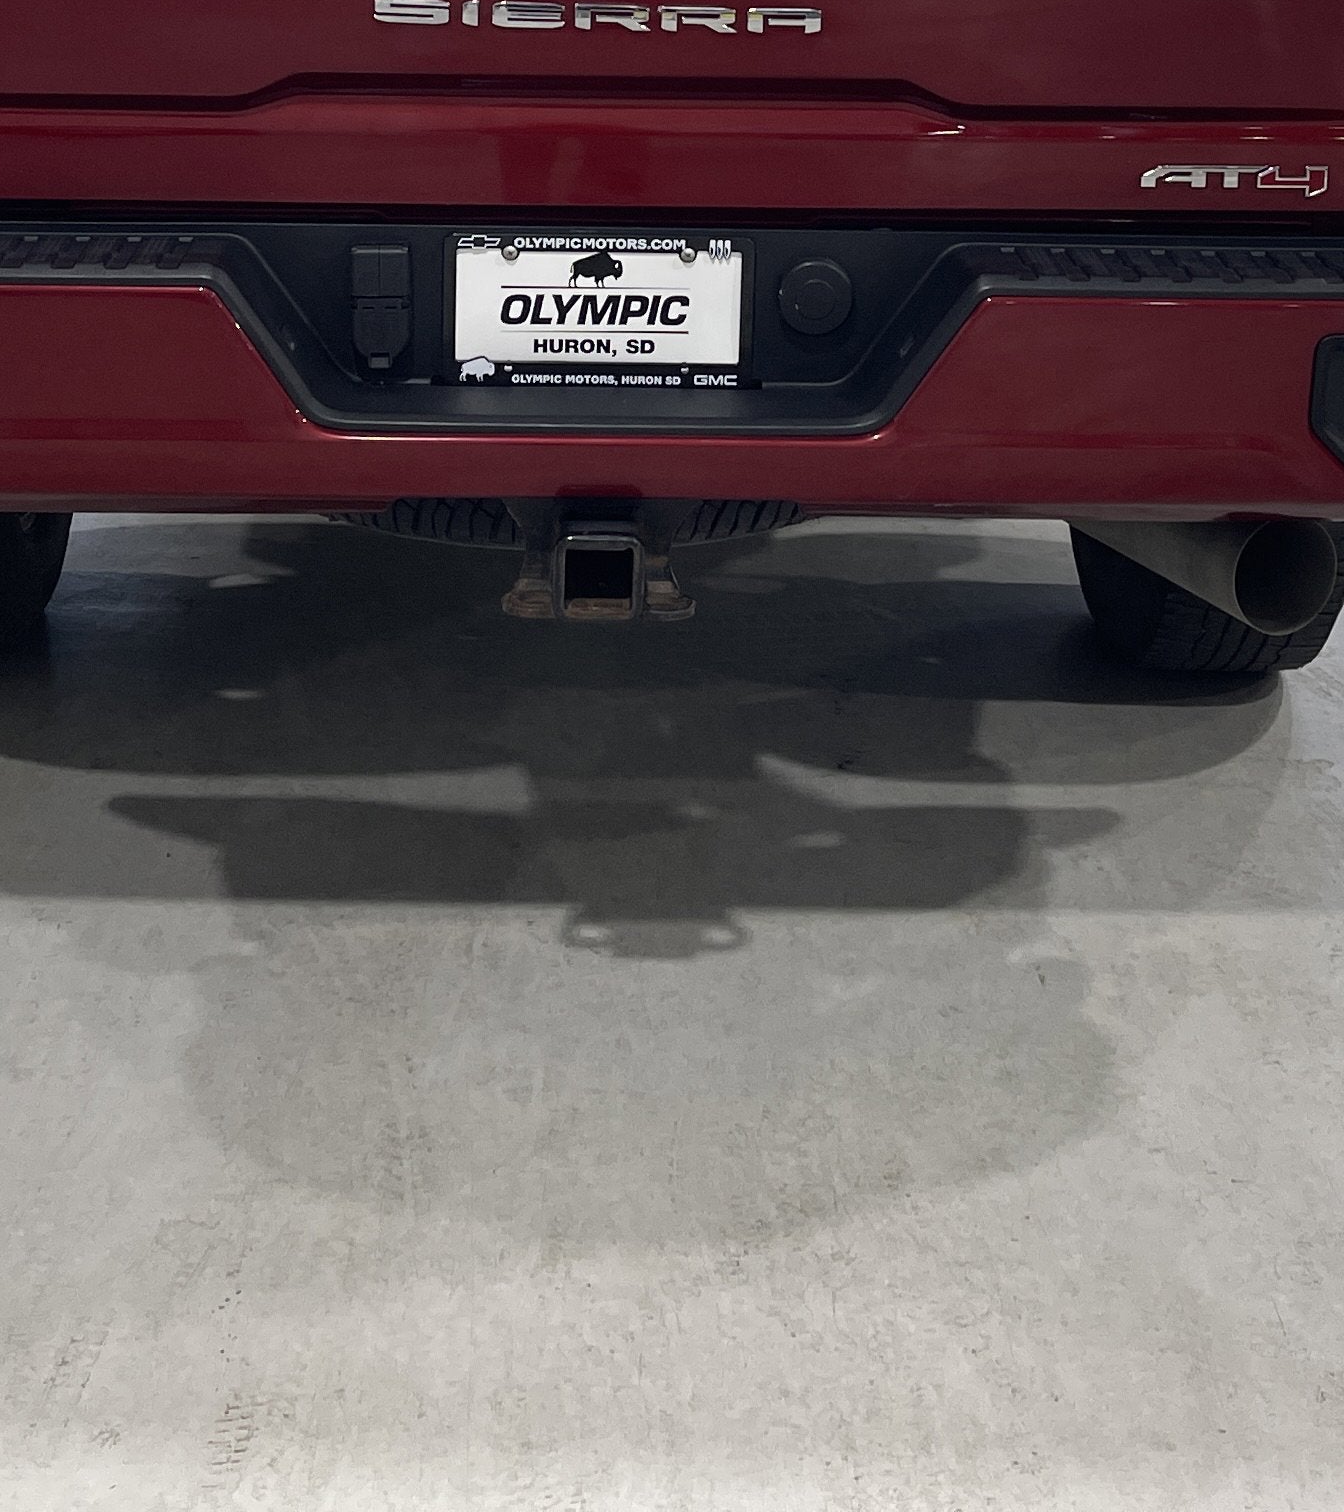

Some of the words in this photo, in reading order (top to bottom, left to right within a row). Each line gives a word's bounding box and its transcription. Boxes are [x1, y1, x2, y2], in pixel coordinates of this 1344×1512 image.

[1140, 164, 1329, 198] AT4
[513, 237, 686, 251] OLYMPICMOTORS.COM
[500, 293, 690, 326] OLYMPIC
[533, 339, 618, 357] HURON,
[626, 339, 655, 355] SD
[511, 374, 562, 384] OLYMPIC
[565, 375, 618, 386] MOTORS,
[621, 375, 662, 385] HURON
[665, 376, 681, 386] SD
[693, 374, 738, 386] GMC
